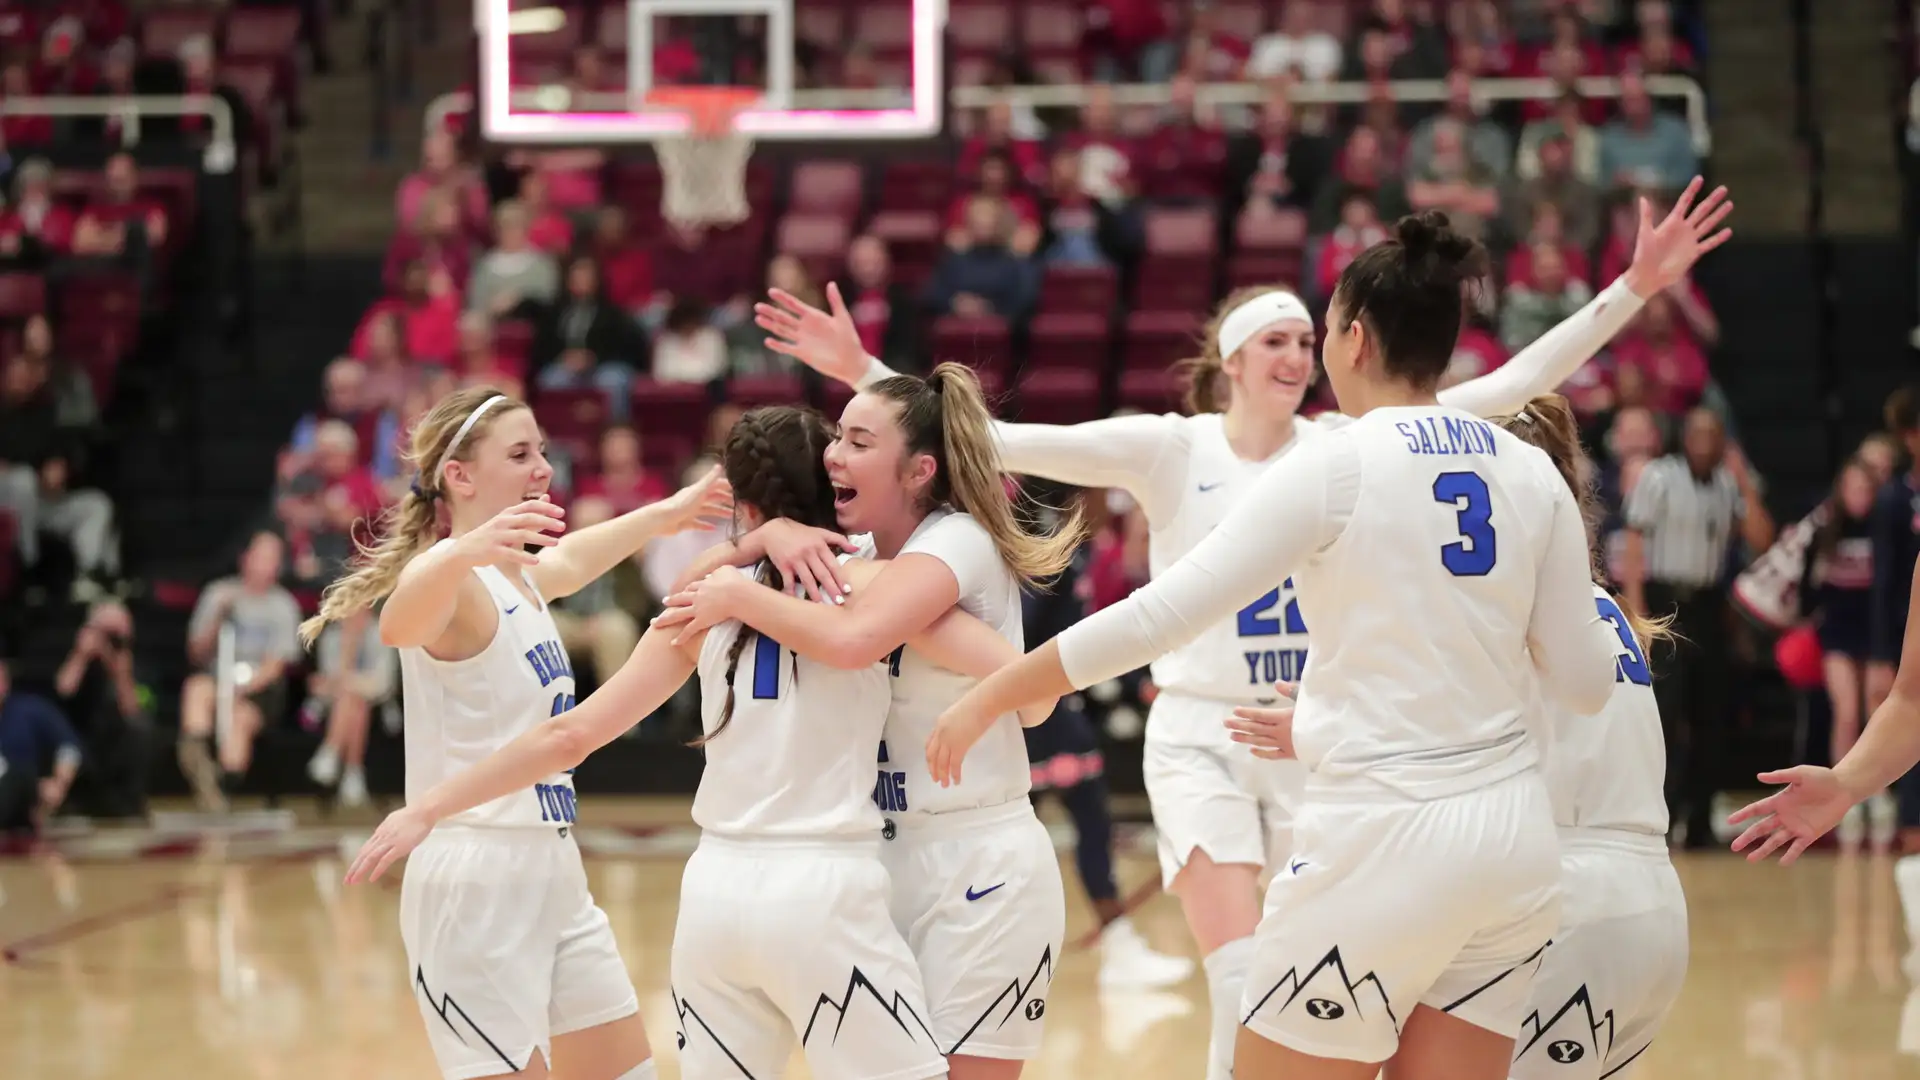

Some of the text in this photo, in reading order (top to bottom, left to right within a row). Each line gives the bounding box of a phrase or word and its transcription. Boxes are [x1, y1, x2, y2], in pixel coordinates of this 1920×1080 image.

[1395, 416, 1497, 457] SALMON
[1432, 471, 1496, 577] 3
[1594, 597, 1652, 687] 3
[1028, 1000, 1044, 1019] Y
[1311, 1000, 1338, 1019] Y
[1555, 1041, 1580, 1062] Y
